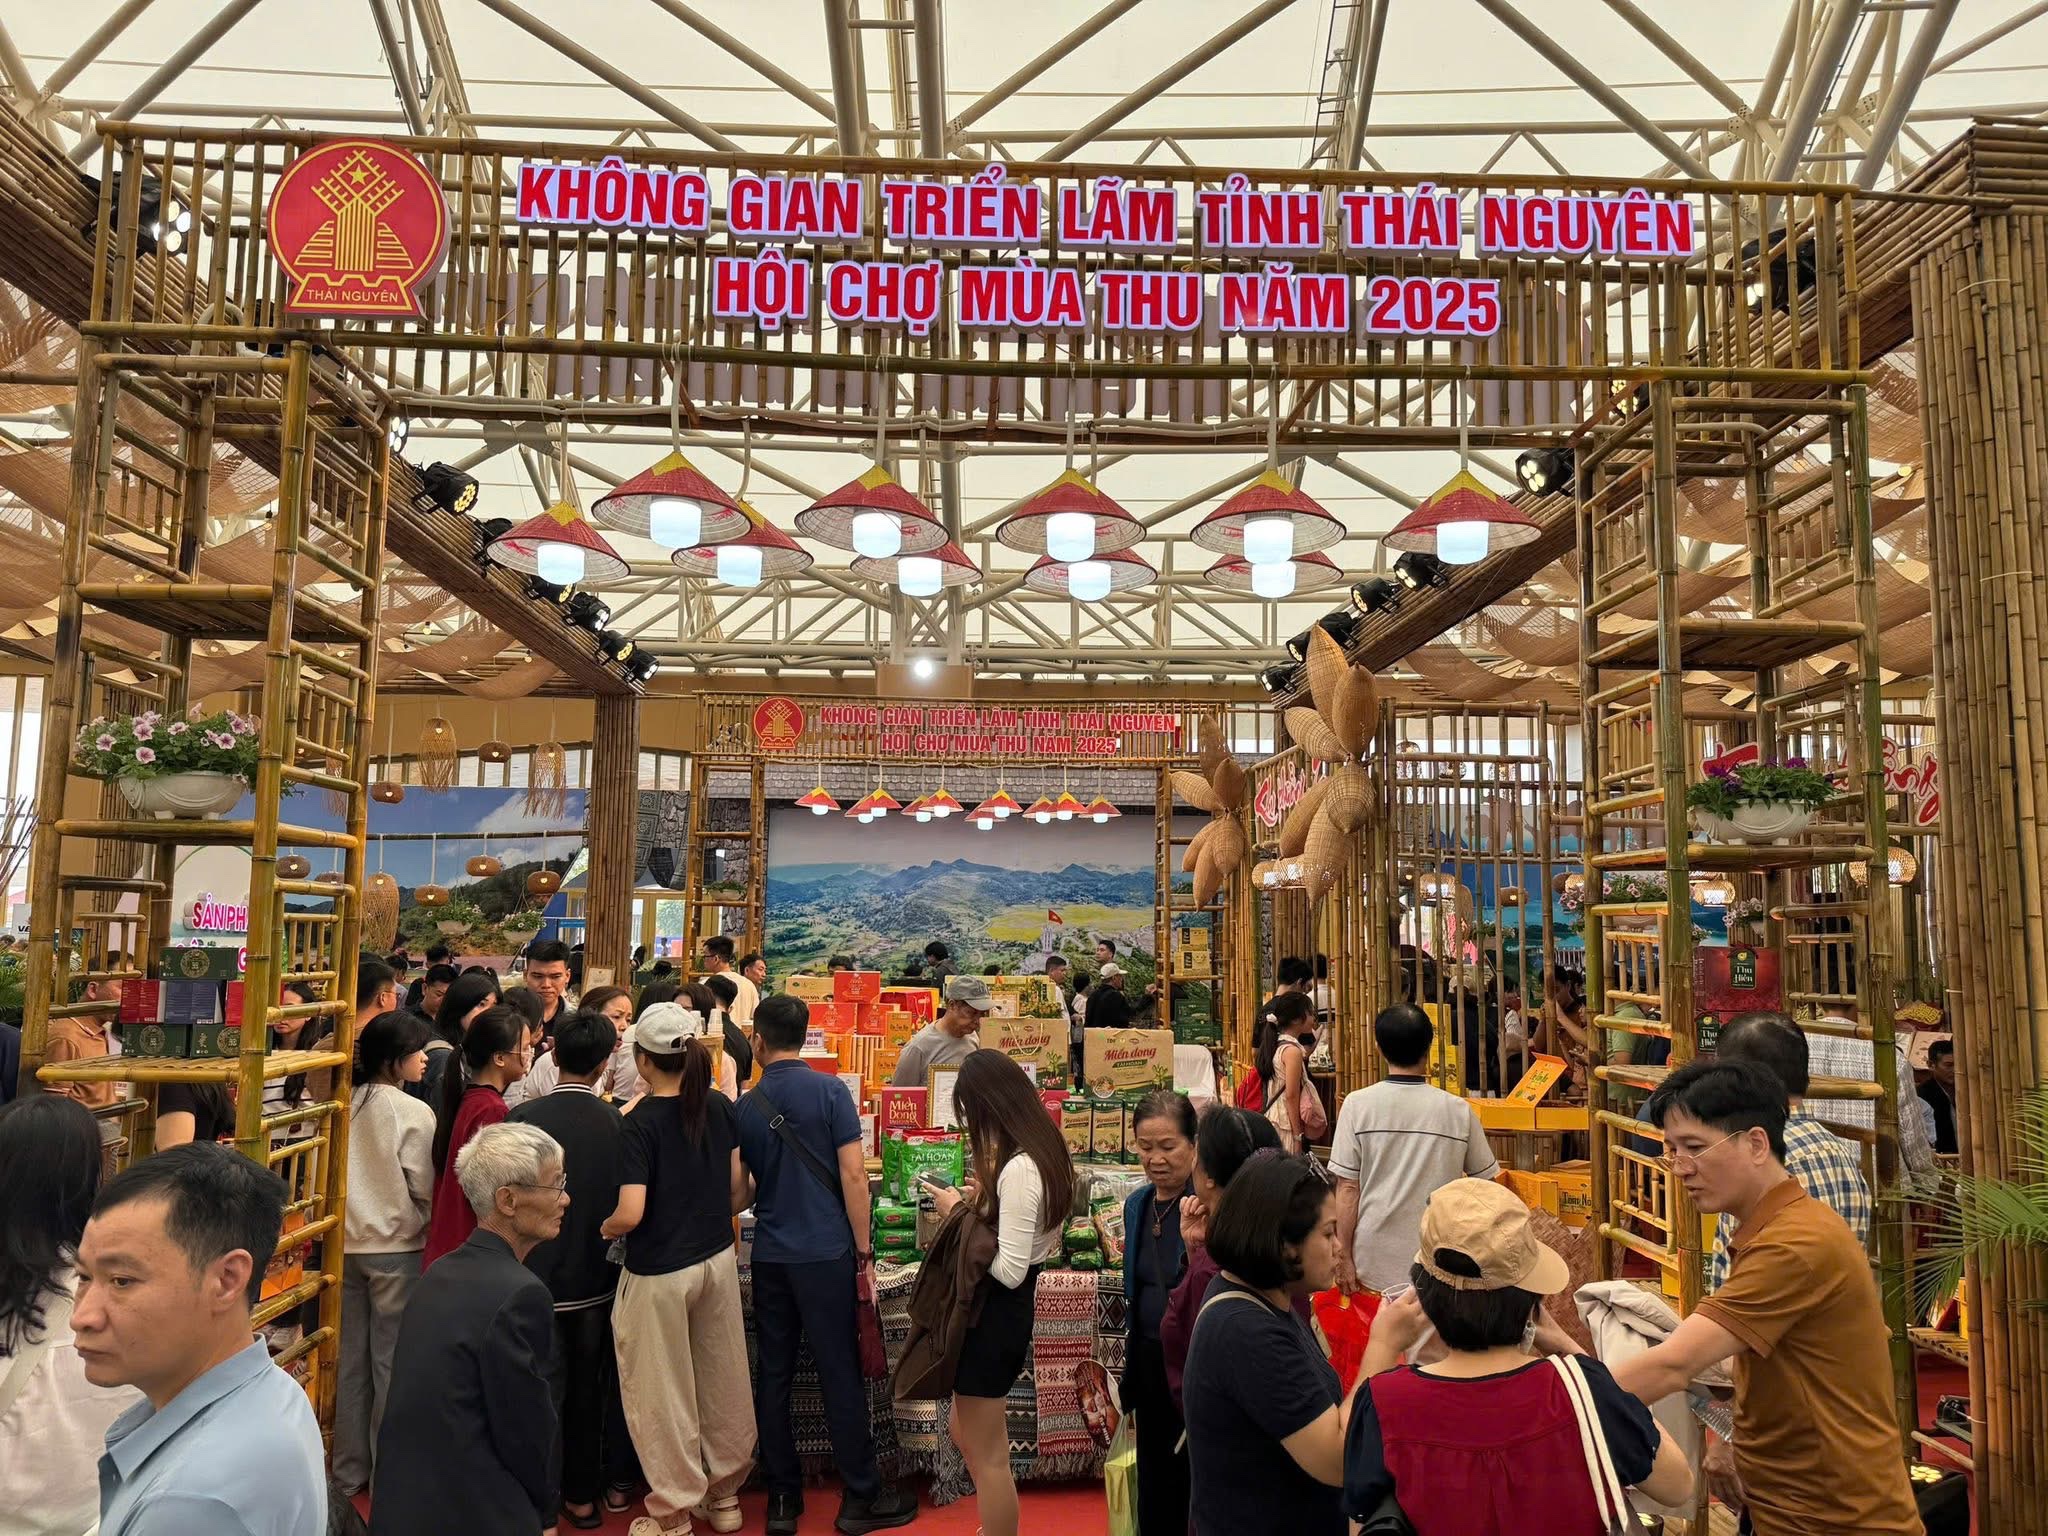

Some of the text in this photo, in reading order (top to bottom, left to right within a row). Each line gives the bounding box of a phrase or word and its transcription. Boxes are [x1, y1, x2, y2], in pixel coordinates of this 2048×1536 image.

[518, 158, 1695, 255] KHÔNG GIAN TRIỂN LÃM TỈNH THÁI NGUYÊN
[307, 287, 398, 303] THÁI NGUYÊN
[715, 249, 1500, 335] HỘI CHỢ MÙA THU NĂM 2025
[820, 703, 1176, 733] KHÔNG GIAN TRIỂN LÃM TỈNH THÁI NGUYÊN
[881, 731, 1117, 756] HỘI CHỢ MÙA THU NĂM 2025
[224, 904, 249, 932] PH
